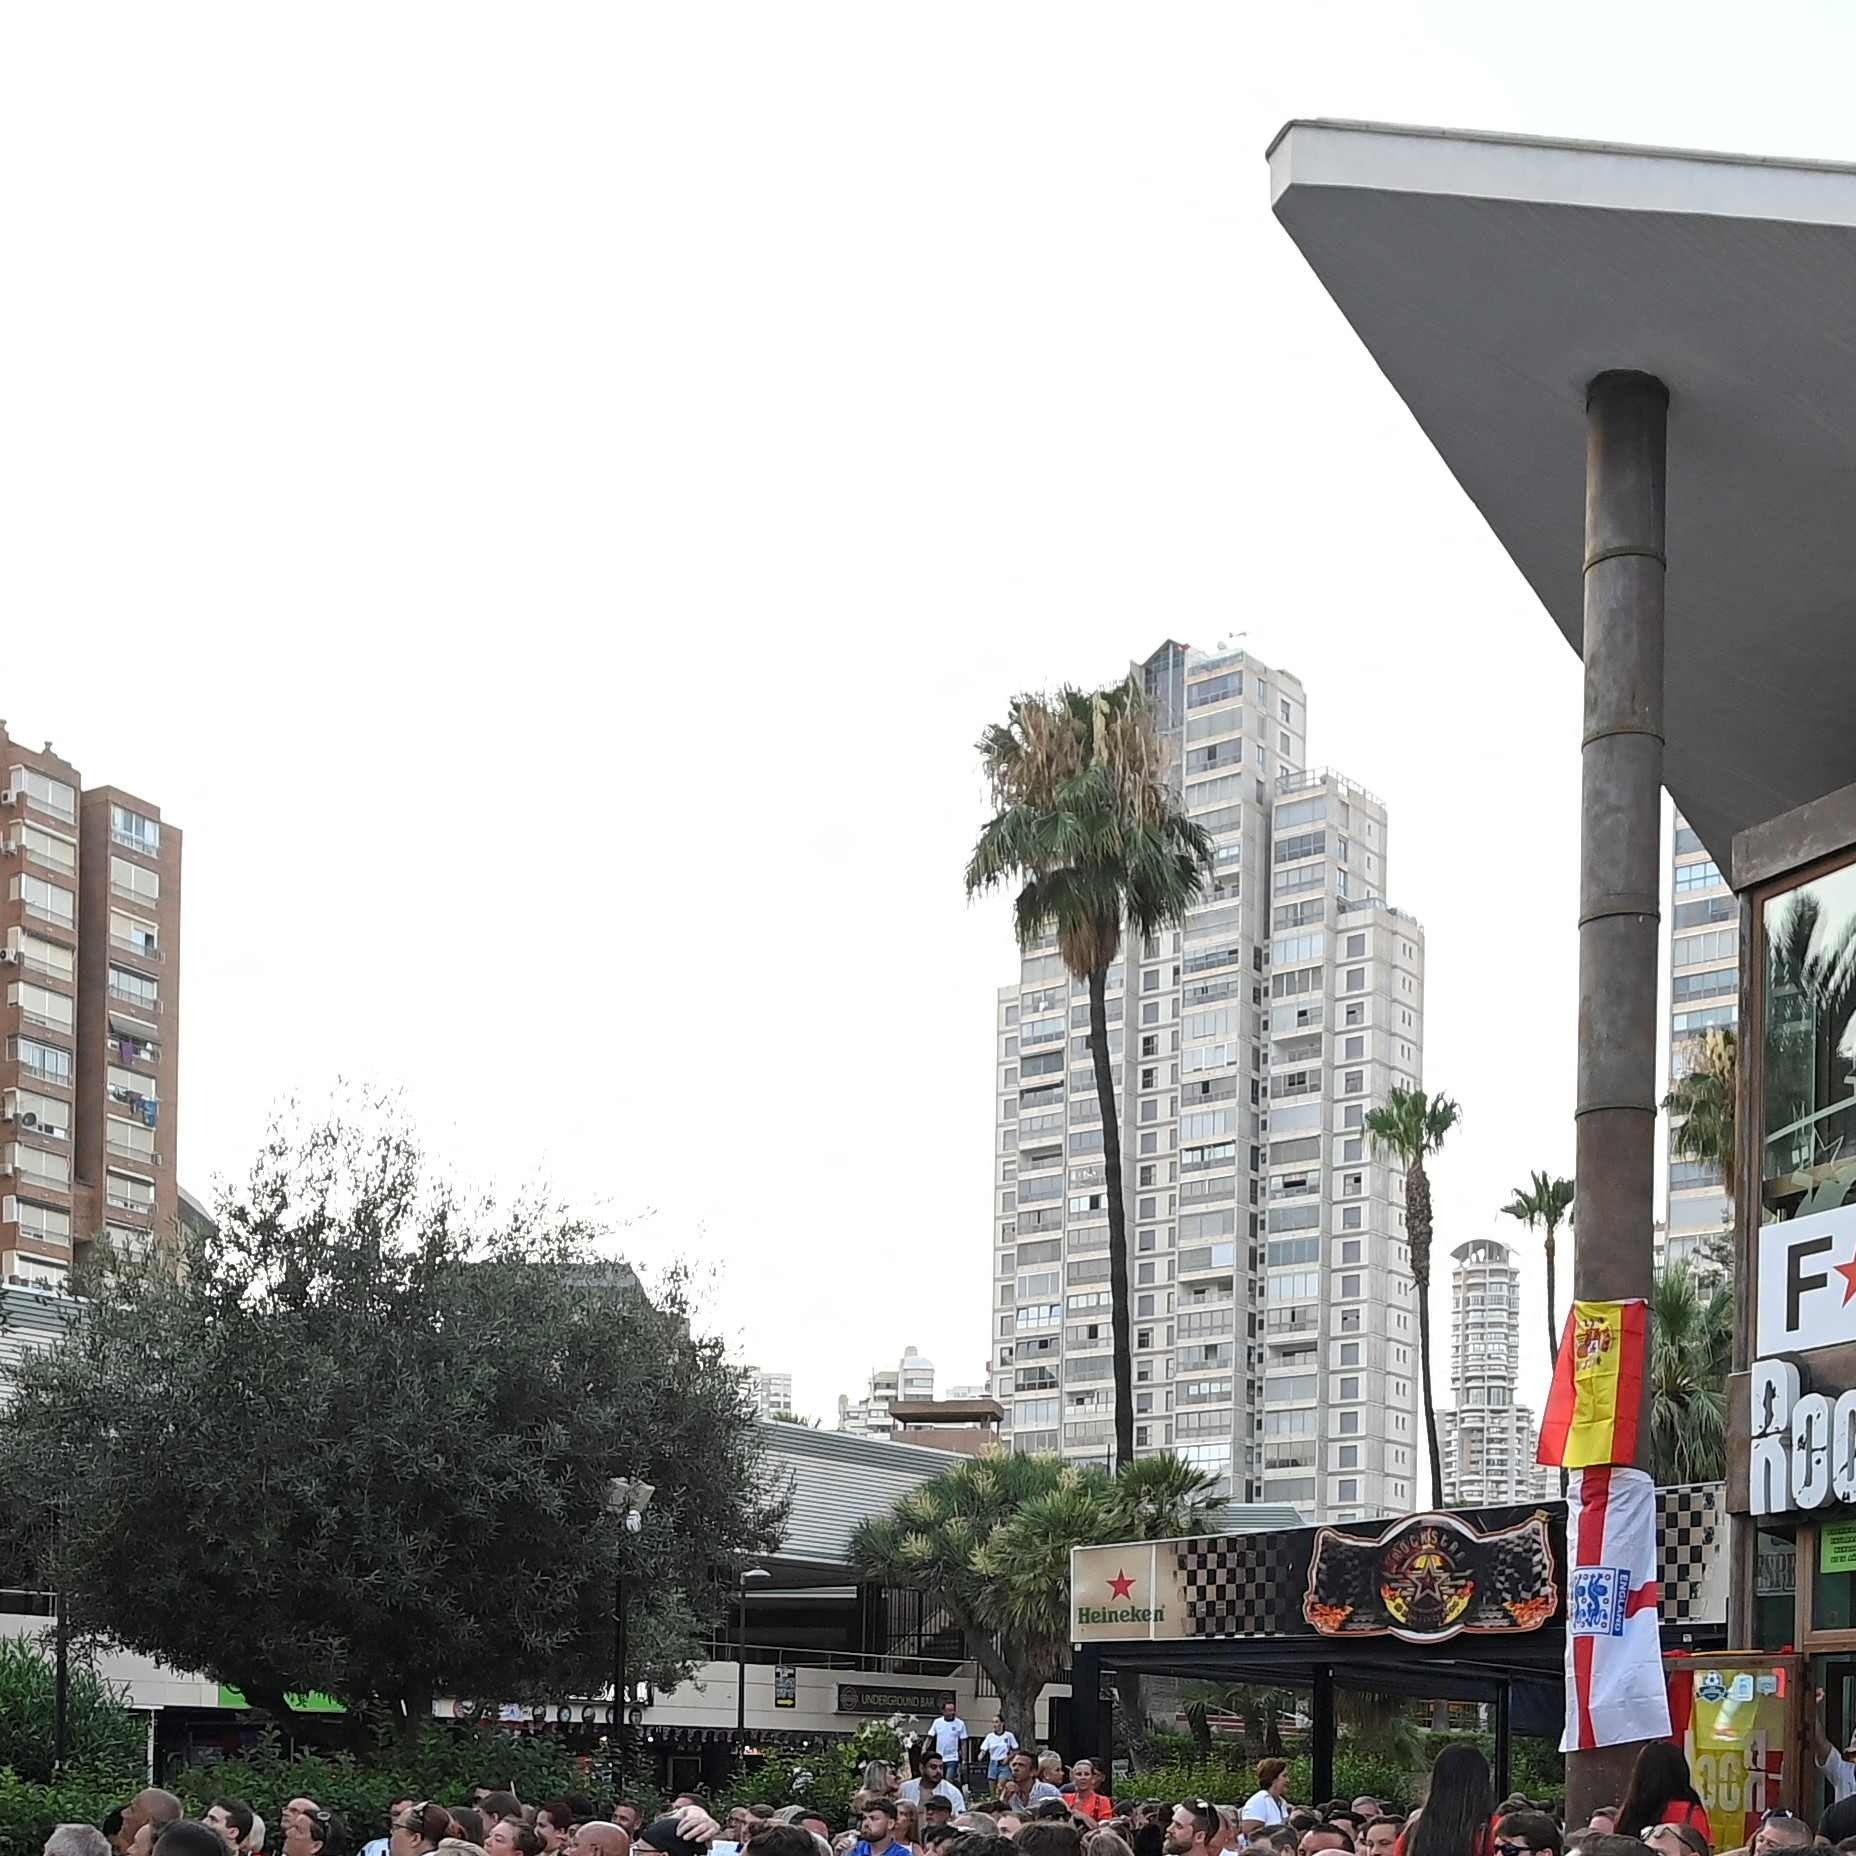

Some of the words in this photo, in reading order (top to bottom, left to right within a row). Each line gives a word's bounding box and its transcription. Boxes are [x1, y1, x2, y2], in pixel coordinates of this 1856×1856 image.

[1612, 1569, 1630, 1635] ENGLAND
[1077, 1605, 1165, 1625] Heineken
[861, 1693, 920, 1707] UNDERGROUND
[920, 1697, 935, 1708] BAR
